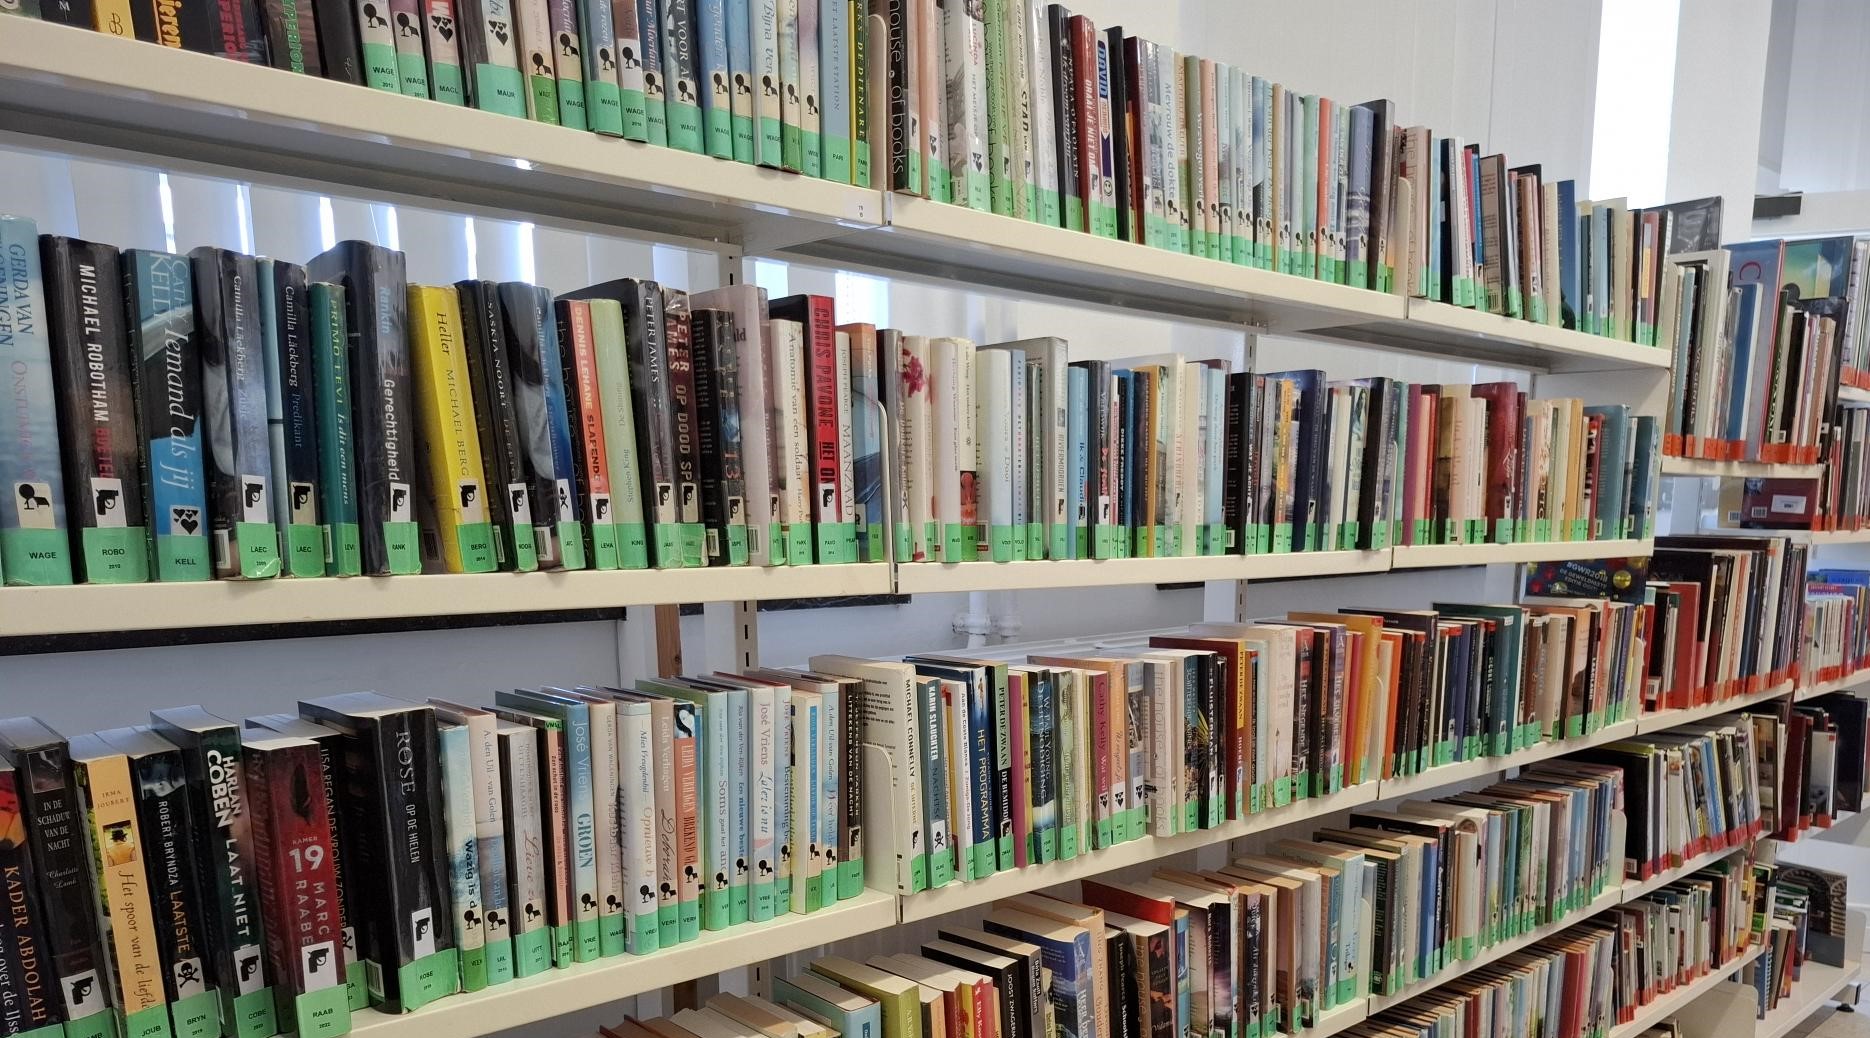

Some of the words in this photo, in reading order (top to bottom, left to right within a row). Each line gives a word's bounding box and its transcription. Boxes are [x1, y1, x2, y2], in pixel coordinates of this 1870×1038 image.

[678, 20, 688, 60] VOOR
[1098, 47, 1108, 96] DAVID
[890, 85, 905, 104] of
[1085, 79, 1093, 108] DRAAI
[1165, 82, 1174, 139] Mevrouw
[1021, 91, 1029, 132] STAD
[1086, 112, 1094, 123] JE
[890, 112, 907, 174] books
[1087, 127, 1095, 149] NIET
[1167, 142, 1174, 158] de
[8, 243, 30, 300] GERDA
[79, 264, 100, 336] MICHAEL
[285, 286, 296, 331] Camilla
[17, 304, 34, 335] VAN
[488, 302, 498, 353] SASKIA
[574, 307, 586, 357] DENNIS
[646, 297, 656, 341] PETER
[814, 308, 830, 358] CHRIS
[164, 327, 195, 421] Iemand
[287, 334, 300, 387] Läckberg
[648, 342, 659, 383] JAMES
[87, 342, 110, 422] ROBOTHAM
[436, 312, 453, 356] Heller
[446, 369, 464, 435] MICHAEL
[456, 440, 469, 476] BERG
[579, 359, 593, 410] LEHANE
[676, 384, 687, 406] OP
[816, 365, 834, 427] PAVONE
[791, 394, 799, 415] van
[169, 426, 196, 459] als
[383, 379, 400, 481] Gerechtigheid
[677, 413, 692, 454] DOOD
[793, 442, 803, 480] soldaat
[821, 441, 835, 461] HET
[160, 461, 195, 490] jij
[842, 424, 854, 516] MAANZAAD
[29, 551, 57, 559] WAGE
[102, 548, 125, 556] ROBO
[759, 703, 770, 726] José
[905, 679, 913, 722] MICHAEL
[928, 686, 936, 712] KARIN
[485, 742, 493, 756] den
[573, 721, 587, 752] José
[760, 730, 772, 766] Vriens
[907, 727, 916, 777] CONNELLY
[929, 714, 937, 761] SLAUGHTER
[977, 729, 985, 753] HET
[396, 731, 416, 795] ROSE
[486, 760, 494, 773] Uil
[681, 745, 694, 769] LEIDA
[207, 750, 233, 828] COBEN
[222, 755, 242, 815] HARLAN
[682, 771, 695, 814] VERHAGEN
[848, 771, 853, 783] DE
[1001, 771, 1009, 784] DE
[43, 803, 52, 811] IN
[53, 800, 62, 809] DE
[405, 804, 416, 816] OP
[488, 798, 496, 823] Golen
[718, 780, 727, 815] Soms
[979, 758, 990, 839] PROGRAMMA
[37, 811, 71, 826] SCHADUW
[44, 828, 59, 838] VAN
[60, 825, 69, 835] DE
[158, 800, 173, 838] ROBERT
[408, 819, 418, 830] DE
[683, 817, 696, 854] BREKEND
[760, 818, 769, 834] nu
[48, 839, 71, 852] NACHT
[288, 844, 324, 873] 19
[409, 832, 421, 864] HIELEN
[576, 814, 593, 869] GROEN
[164, 840, 178, 886] BRYNDZA
[225, 838, 244, 886] LAAT
[465, 840, 477, 880] Wazig
[119, 870, 137, 896] Het
[468, 884, 475, 895] is
[120, 902, 137, 931] spoor
[170, 891, 190, 953] LAATSTE
[233, 894, 250, 937] NIET
[295, 880, 314, 944] RAABE
[313, 882, 329, 935] MARC
[4, 865, 28, 928] KADER
[17, 934, 47, 1021] ABDOLAH
[131, 935, 142, 958] van
[136, 963, 150, 975] de
[3, 991, 18, 1007] de
[1007, 974, 1015, 1000] JOOST
[186, 1015, 206, 1026] BRYN
[248, 1008, 267, 1020] COBE
[312, 1007, 333, 1019] RAAB
[142, 1025, 162, 1037] JOUB
